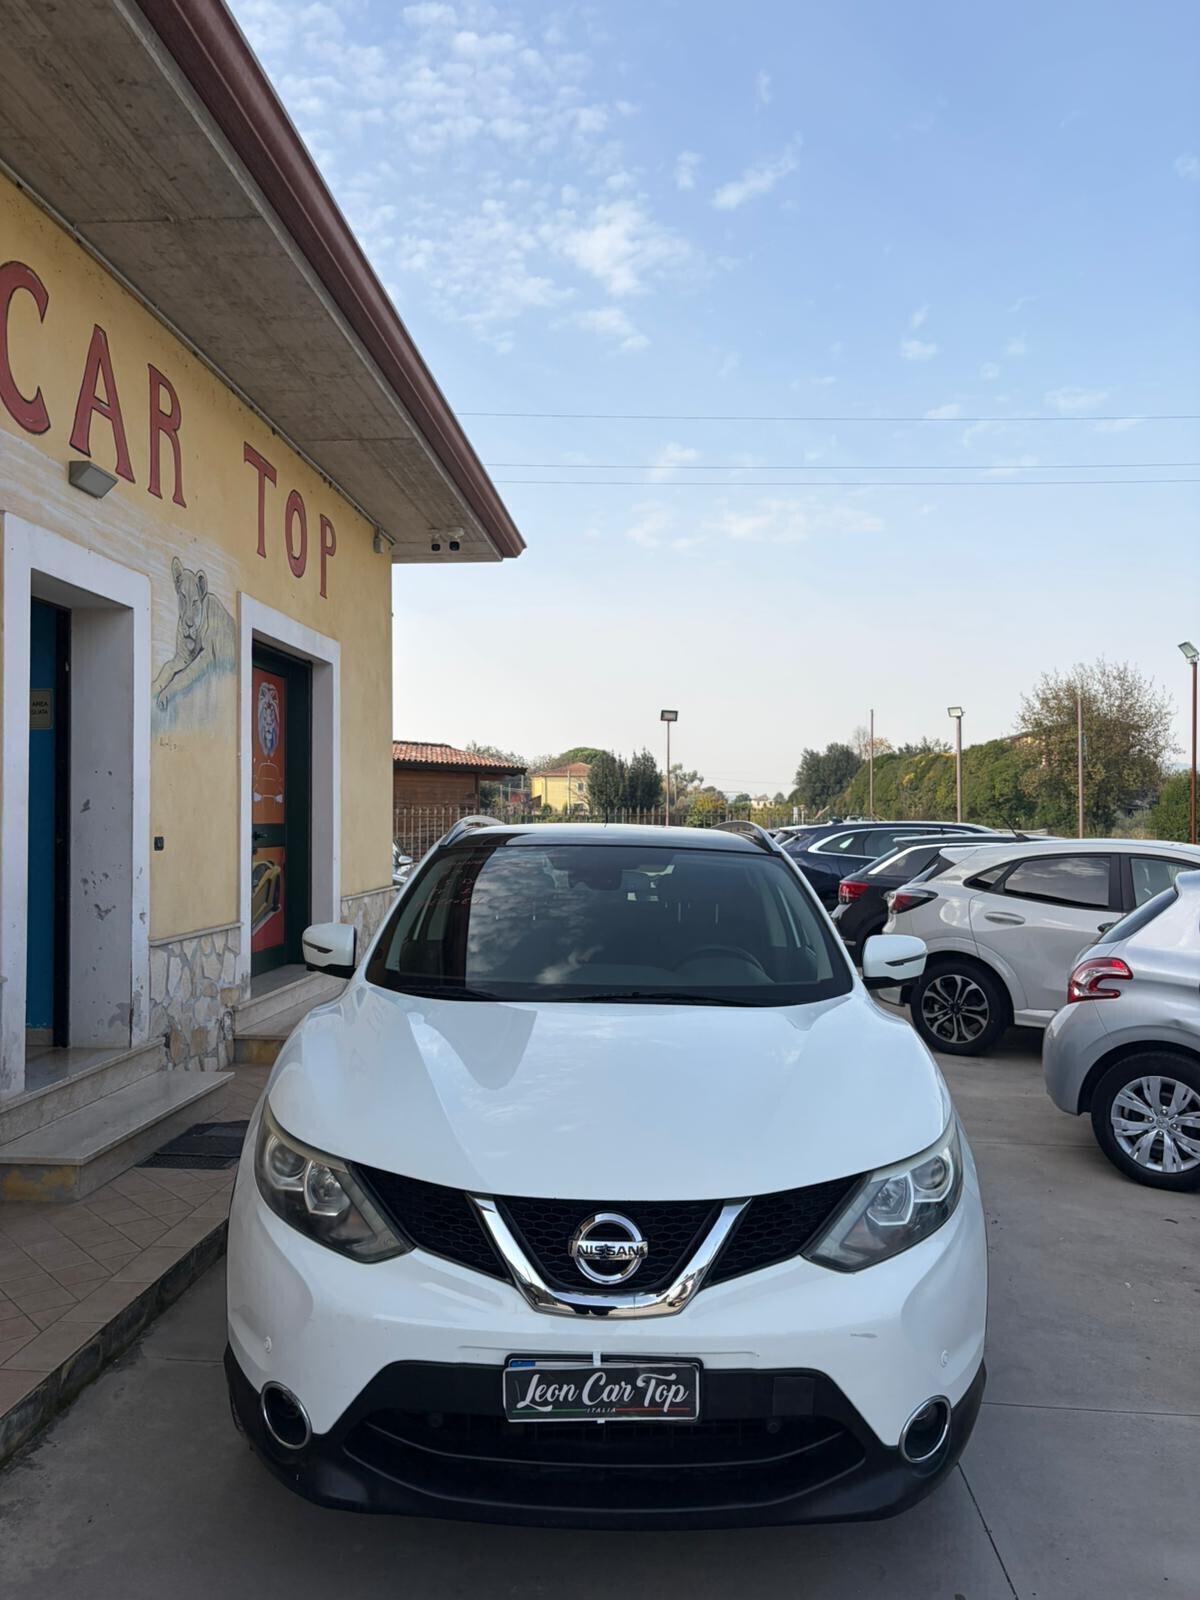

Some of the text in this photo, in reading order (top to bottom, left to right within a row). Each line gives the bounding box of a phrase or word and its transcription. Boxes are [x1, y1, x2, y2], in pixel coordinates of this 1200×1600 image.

[0, 260, 337, 599] CAR TOP
[578, 1244, 641, 1256] NISSAN
[516, 1372, 689, 1413] Leon Car Top
